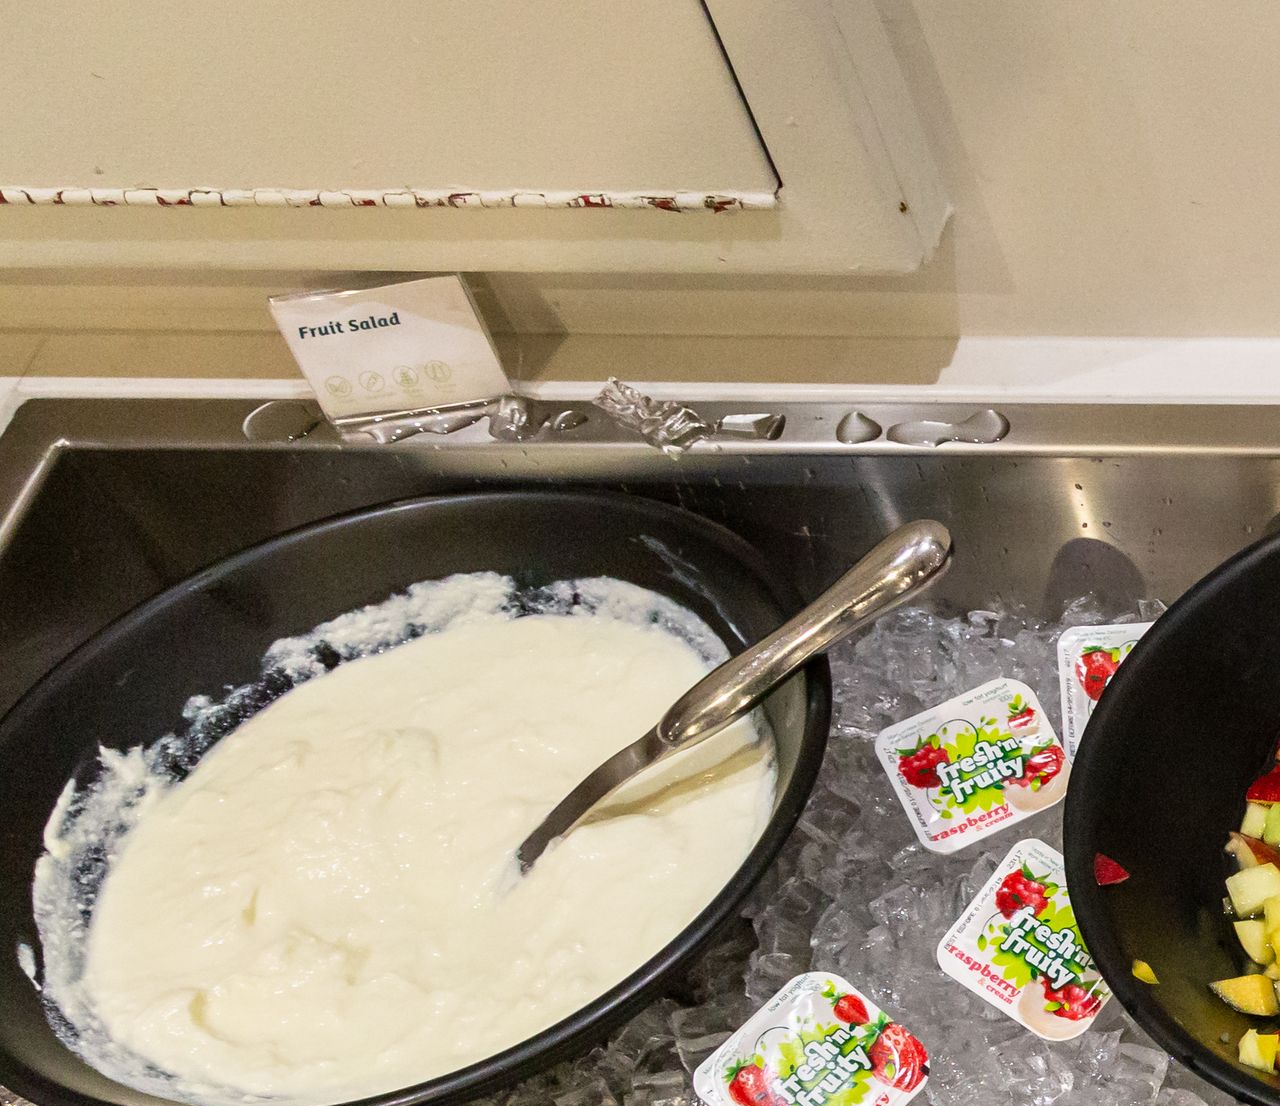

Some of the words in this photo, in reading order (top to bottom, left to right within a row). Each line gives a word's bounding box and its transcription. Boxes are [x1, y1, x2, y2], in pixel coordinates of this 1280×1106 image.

[299, 322, 344, 339] Fruit
[349, 312, 401, 332] Salad
[950, 755, 1024, 804] fruity
[931, 802, 1010, 841] raspberry
[985, 812, 1013, 829] cream
[948, 945, 1021, 997] raspberry
[1000, 928, 1076, 989] fruity
[986, 984, 1013, 1005] cream
